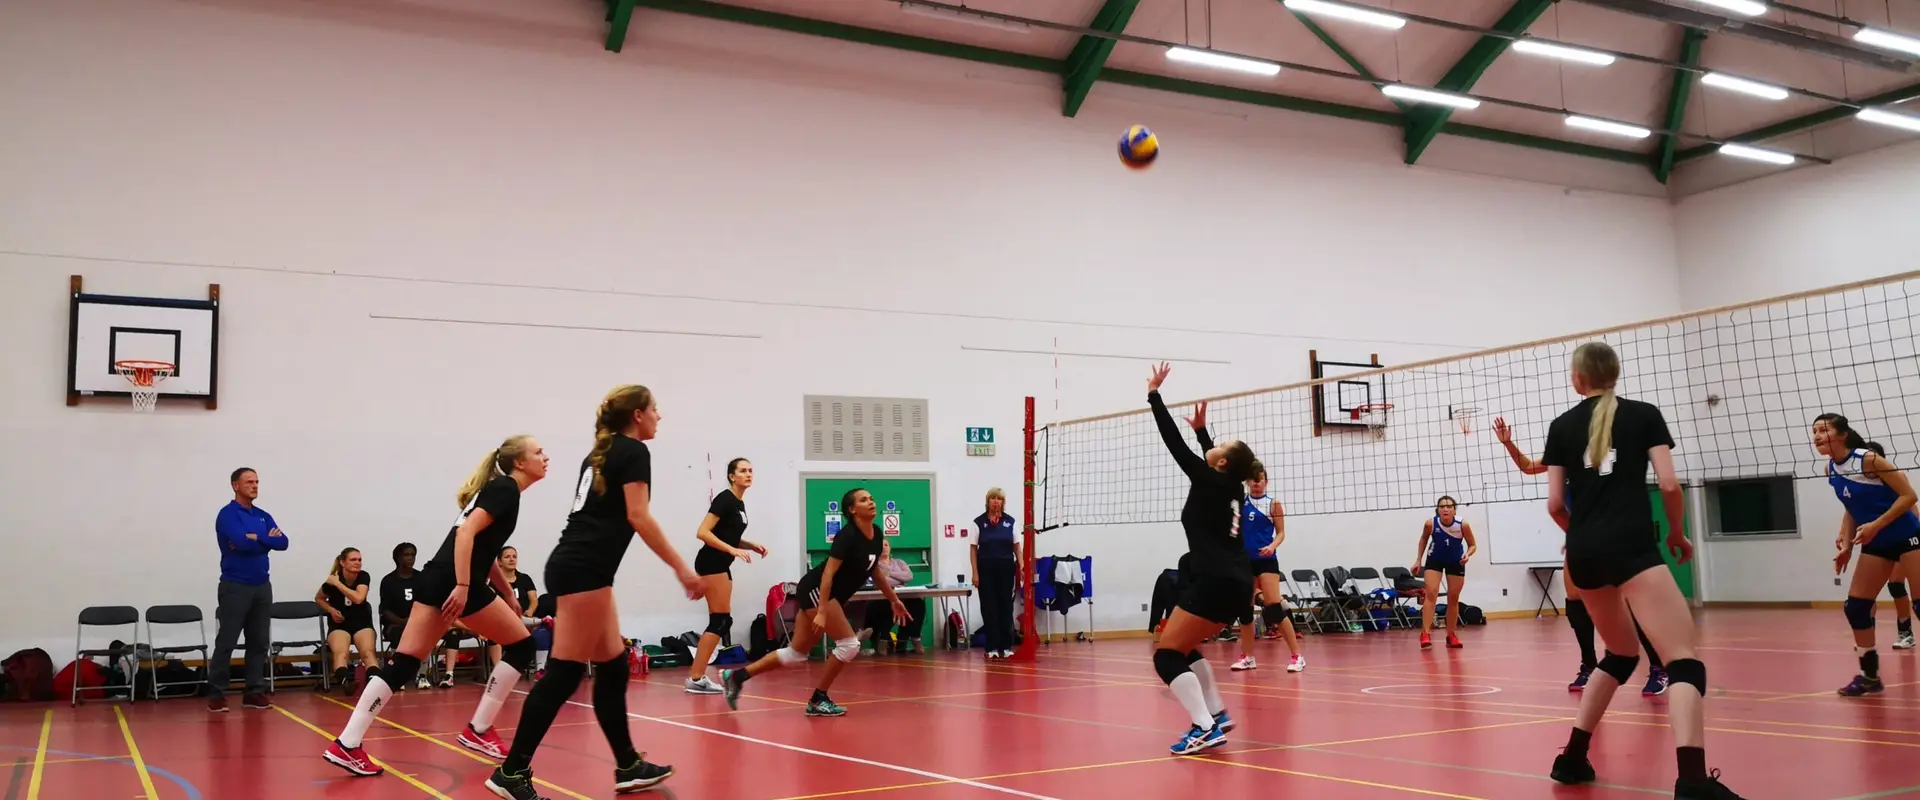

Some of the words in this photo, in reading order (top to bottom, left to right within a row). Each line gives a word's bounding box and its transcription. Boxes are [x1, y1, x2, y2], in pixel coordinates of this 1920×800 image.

[1843, 486, 1851, 498] 4
[1908, 536, 1919, 546] 10
[866, 554, 876, 571] 7
[404, 588, 414, 601] 5
